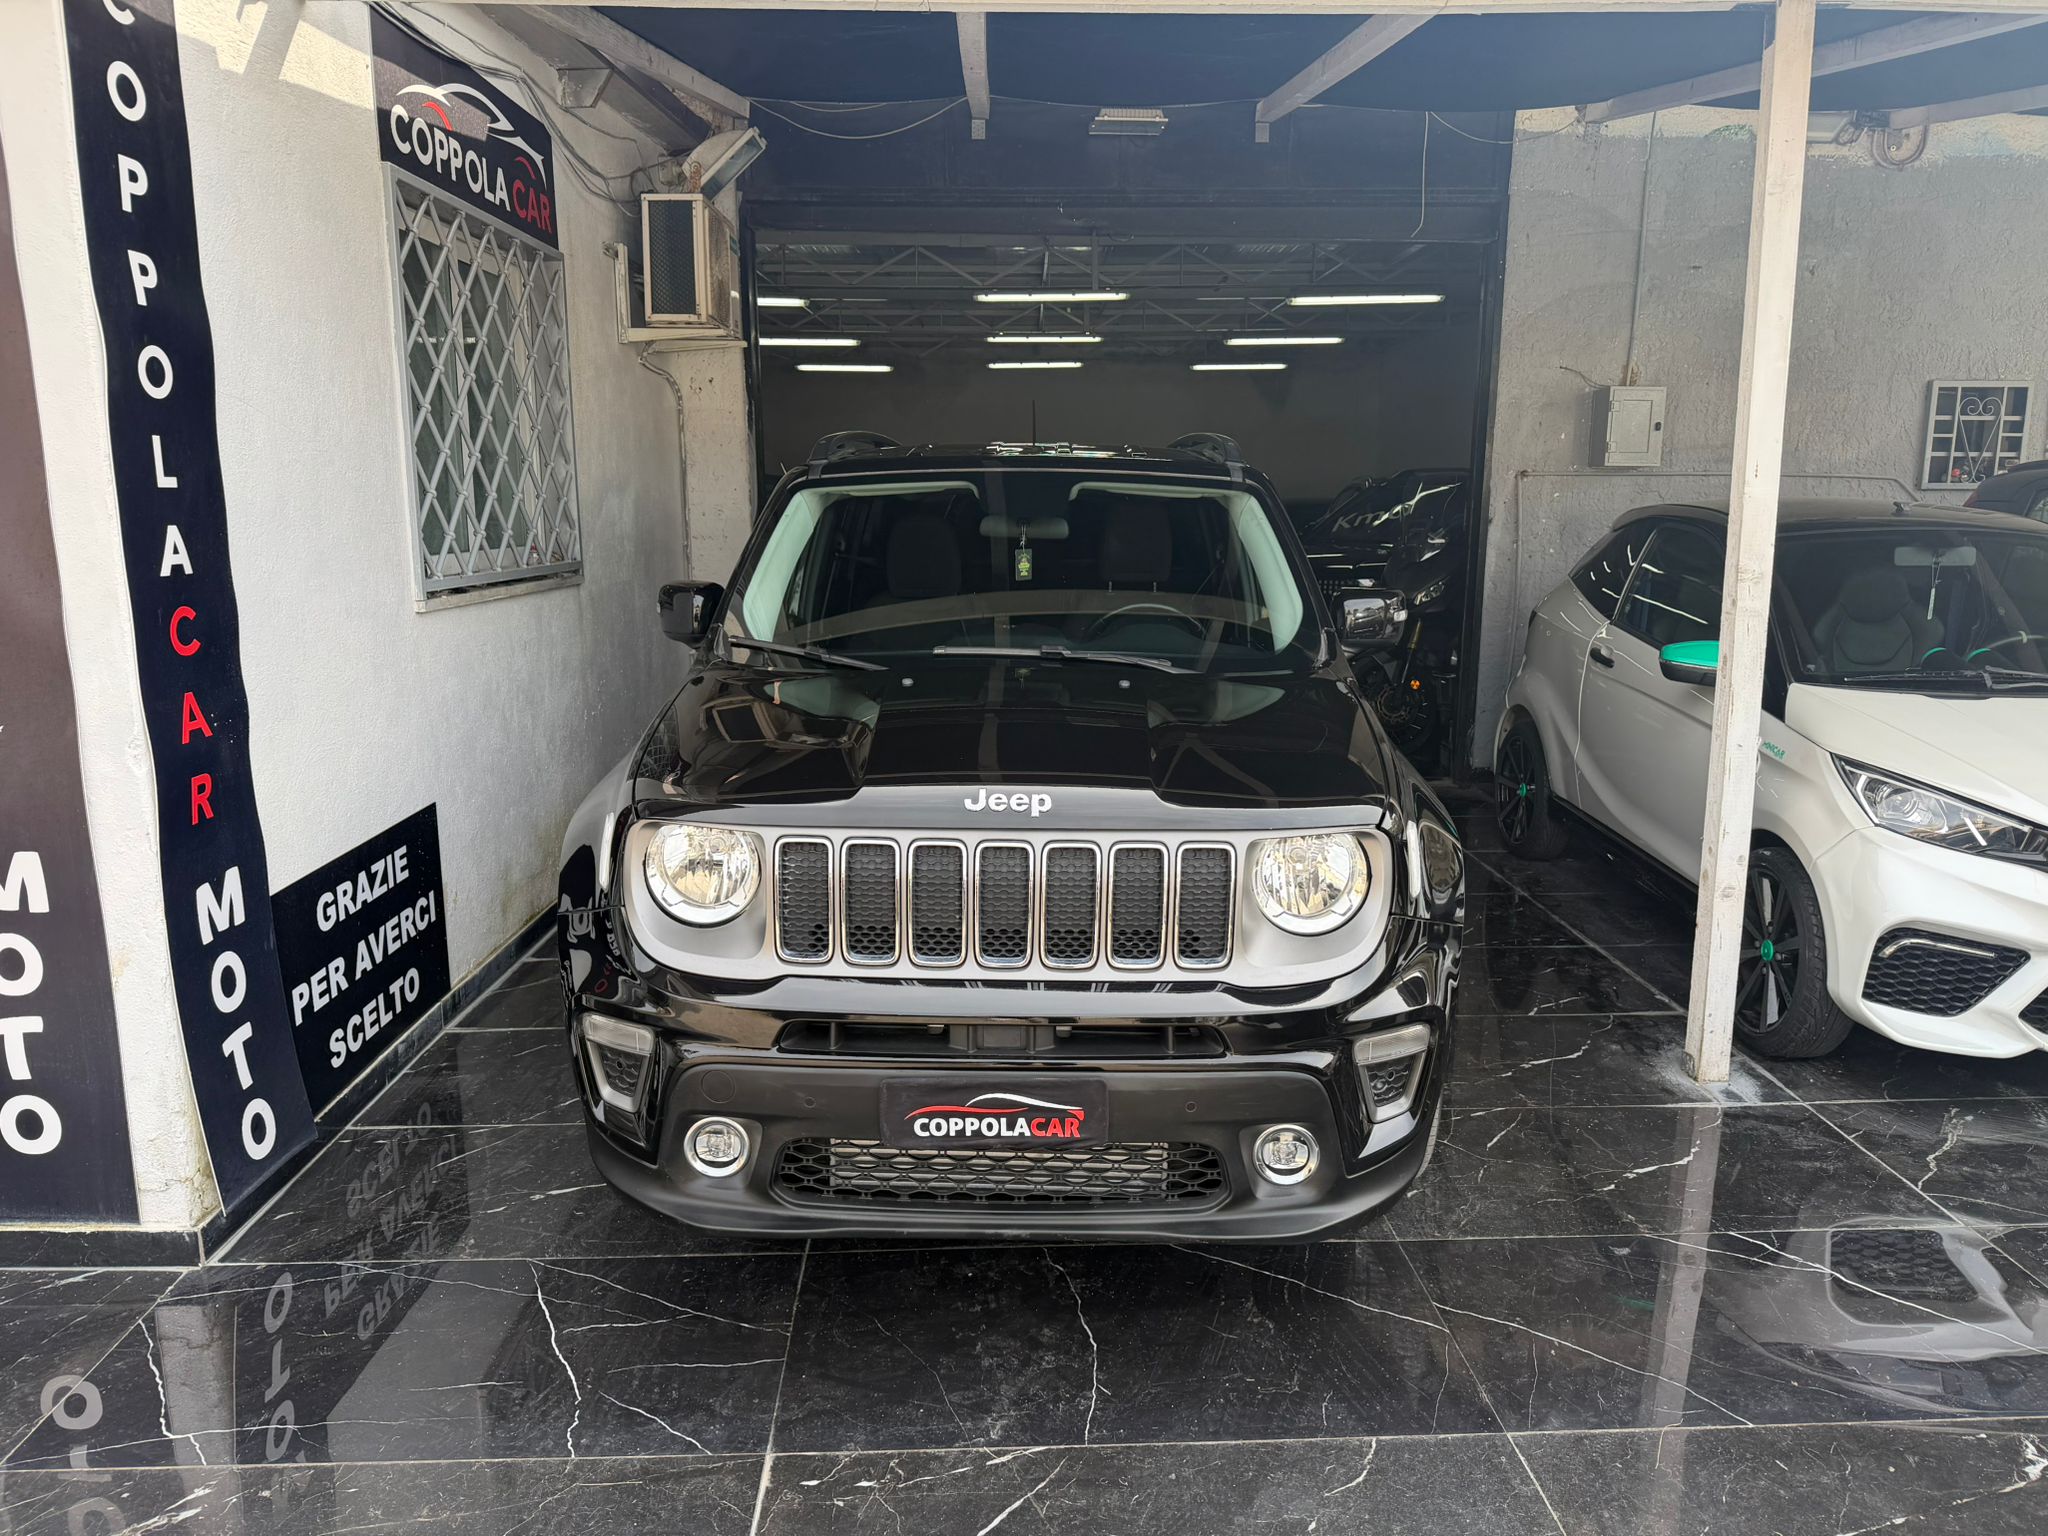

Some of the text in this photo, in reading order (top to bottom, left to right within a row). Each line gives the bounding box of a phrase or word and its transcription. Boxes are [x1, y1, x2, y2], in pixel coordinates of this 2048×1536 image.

[963, 787, 1052, 818] Jeep
[316, 845, 410, 932] GRAZIE
[291, 890, 437, 1027] PER AVERCI
[196, 866, 276, 1161] MOTO
[329, 967, 420, 1069] SCELTO
